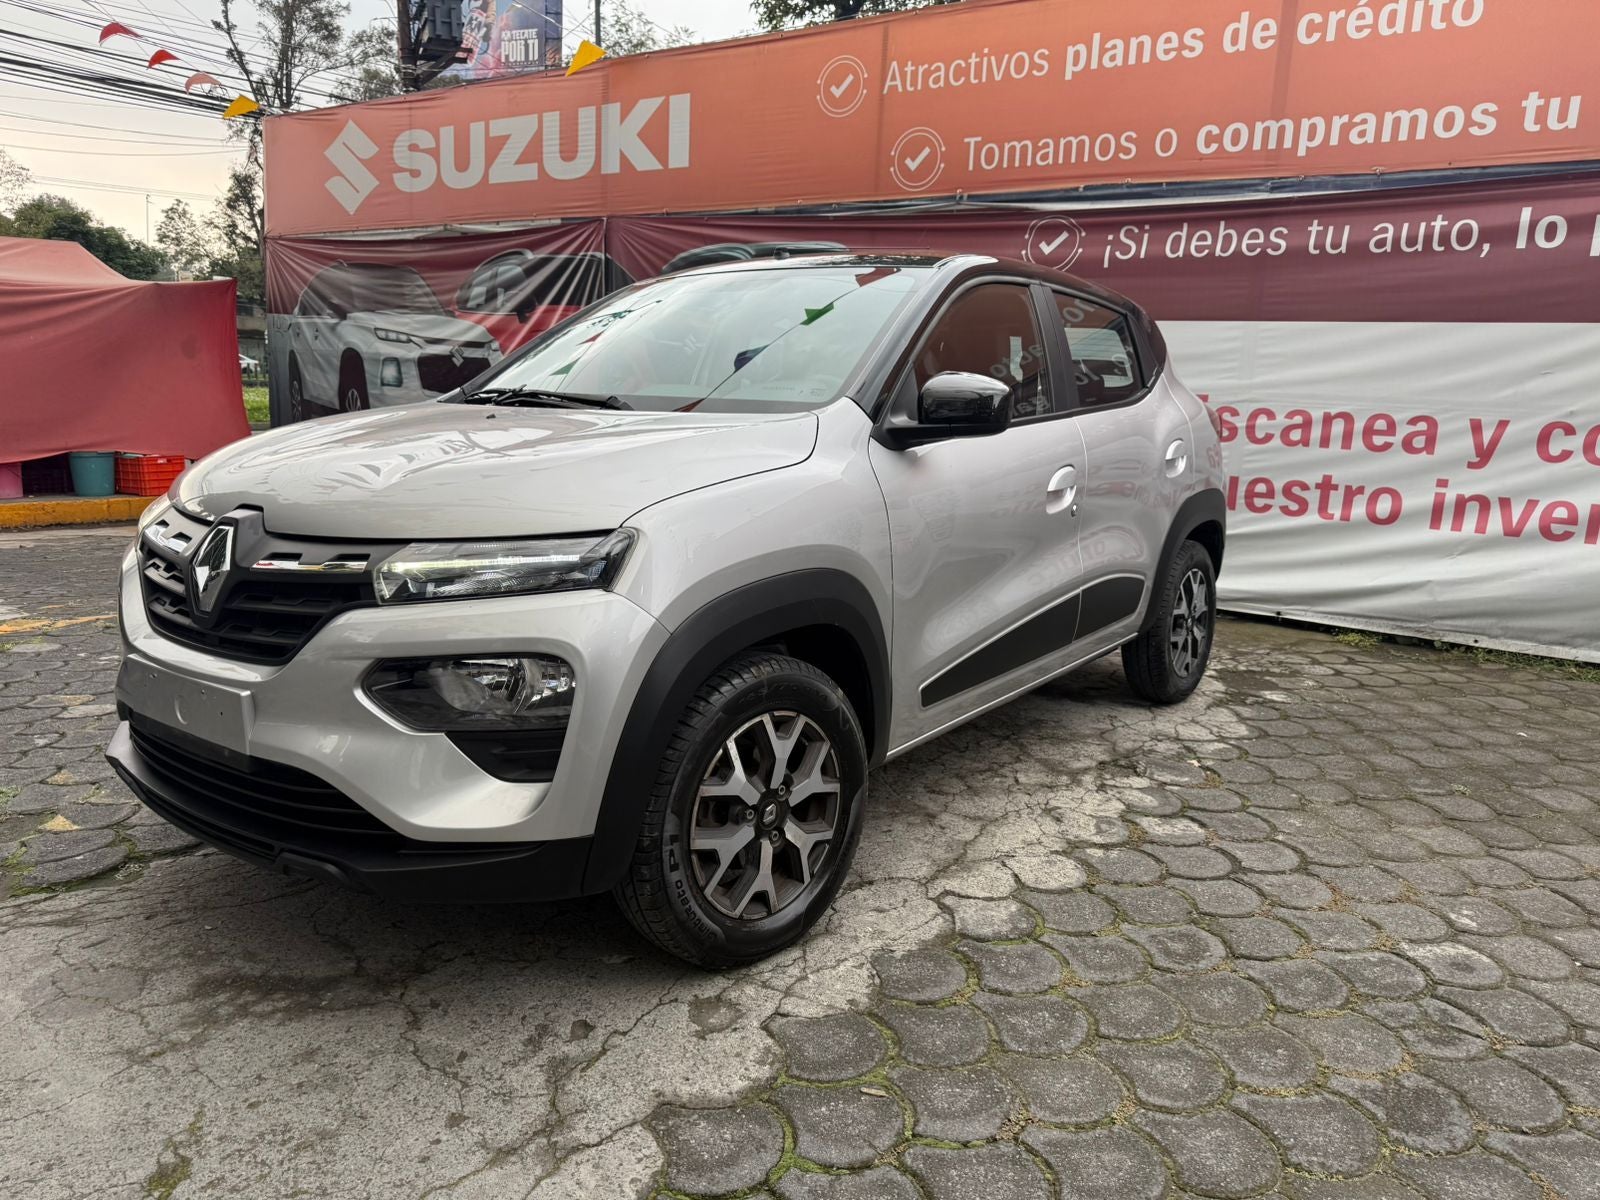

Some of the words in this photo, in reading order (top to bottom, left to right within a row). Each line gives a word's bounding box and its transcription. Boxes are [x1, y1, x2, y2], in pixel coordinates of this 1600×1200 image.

[501, 40, 526, 62] POR
[528, 39, 539, 61] TI
[512, 29, 538, 40] TECATE
[882, 50, 1050, 95] Atractivos
[1064, 27, 1206, 81] planes
[1221, 10, 1280, 55] de
[1294, 0, 1486, 47] crédito
[393, 93, 691, 194] SUZUKI
[963, 126, 1138, 174] Tomamos
[1154, 127, 1180, 160] o
[1195, 100, 1500, 156] compramos
[1520, 89, 1584, 135] tu
[1103, 222, 1150, 269] ¡Si
[1164, 220, 1289, 260] debes
[1307, 219, 1351, 255] tu
[1368, 213, 1491, 258] auto,
[1515, 205, 1569, 250] lo
[1194, 393, 1440, 456] scanea
[1466, 416, 1511, 471] y
